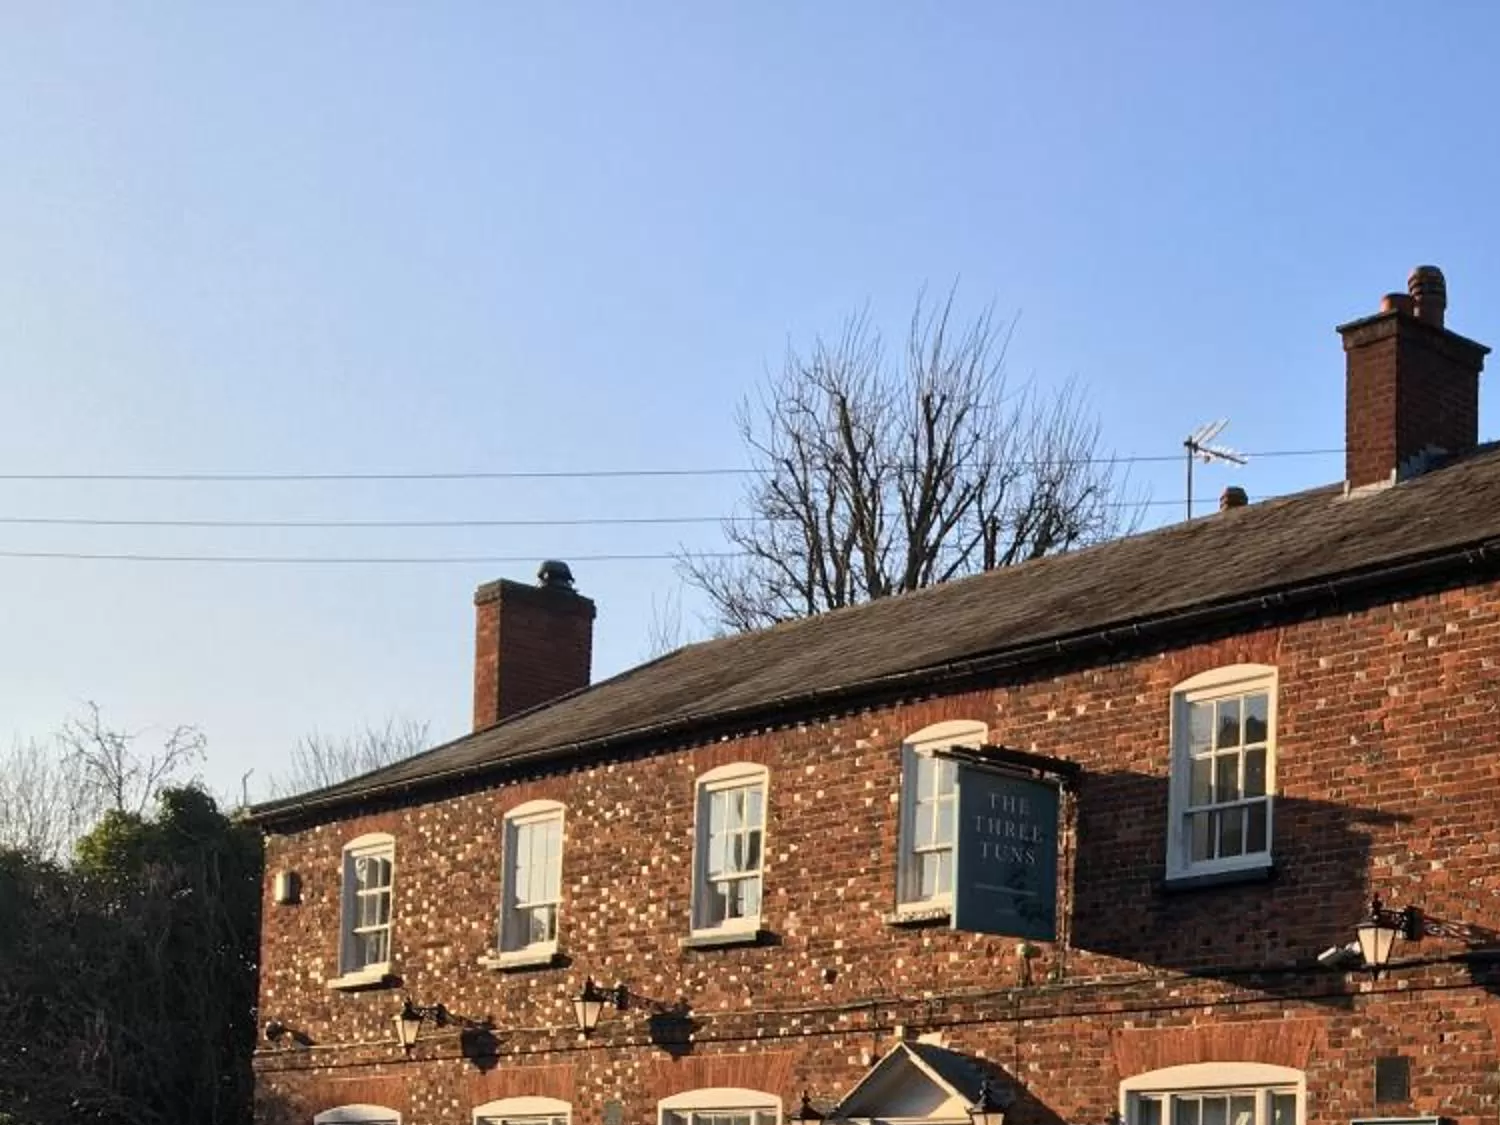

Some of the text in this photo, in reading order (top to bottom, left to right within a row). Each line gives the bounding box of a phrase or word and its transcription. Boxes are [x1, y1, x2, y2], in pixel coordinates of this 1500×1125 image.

[988, 791, 1032, 816] THE
[973, 815, 1044, 844] THREE
[980, 841, 1037, 865] TUNS
